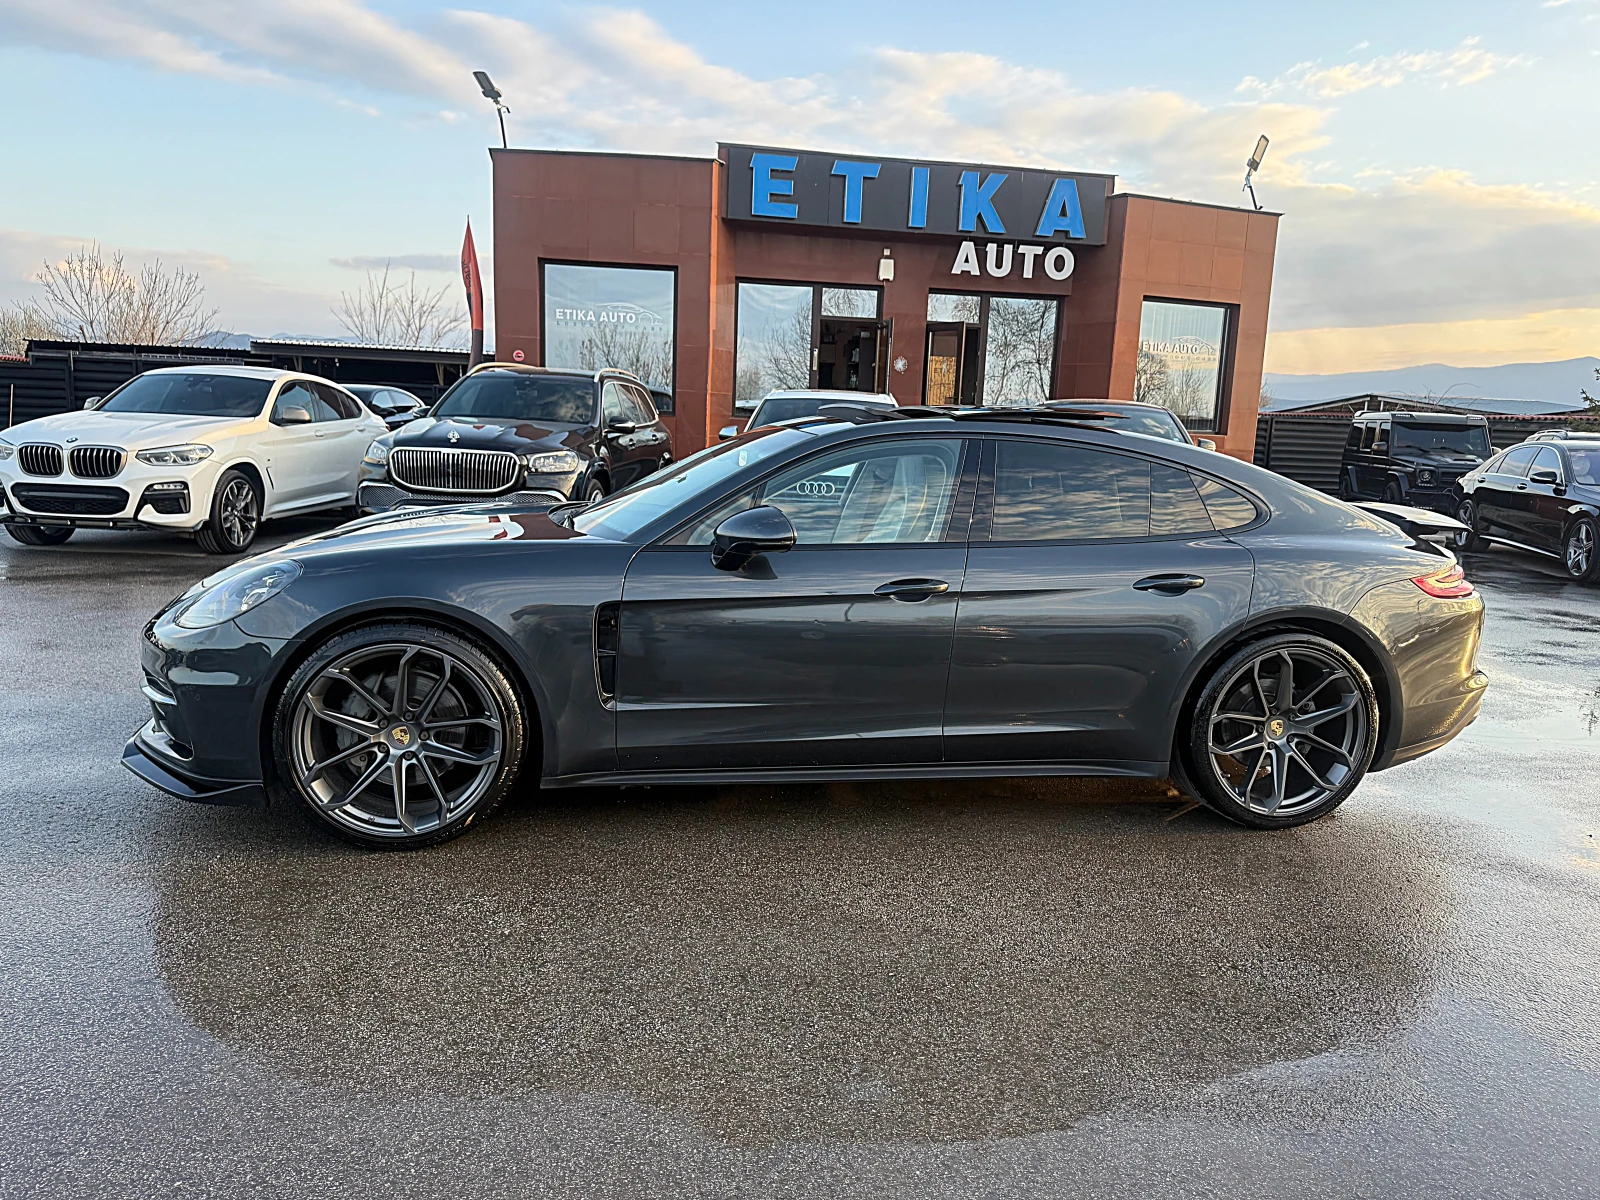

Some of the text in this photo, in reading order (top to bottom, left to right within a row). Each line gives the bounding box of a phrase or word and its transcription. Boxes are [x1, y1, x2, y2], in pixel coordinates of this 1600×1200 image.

[750, 153, 1086, 239] ETIKA
[951, 241, 1075, 280] AUTO
[556, 308, 636, 323] ETIKA AUTO
[556, 320, 625, 329] LUXURS
[1142, 341, 1200, 354] ETIKA AUTO
